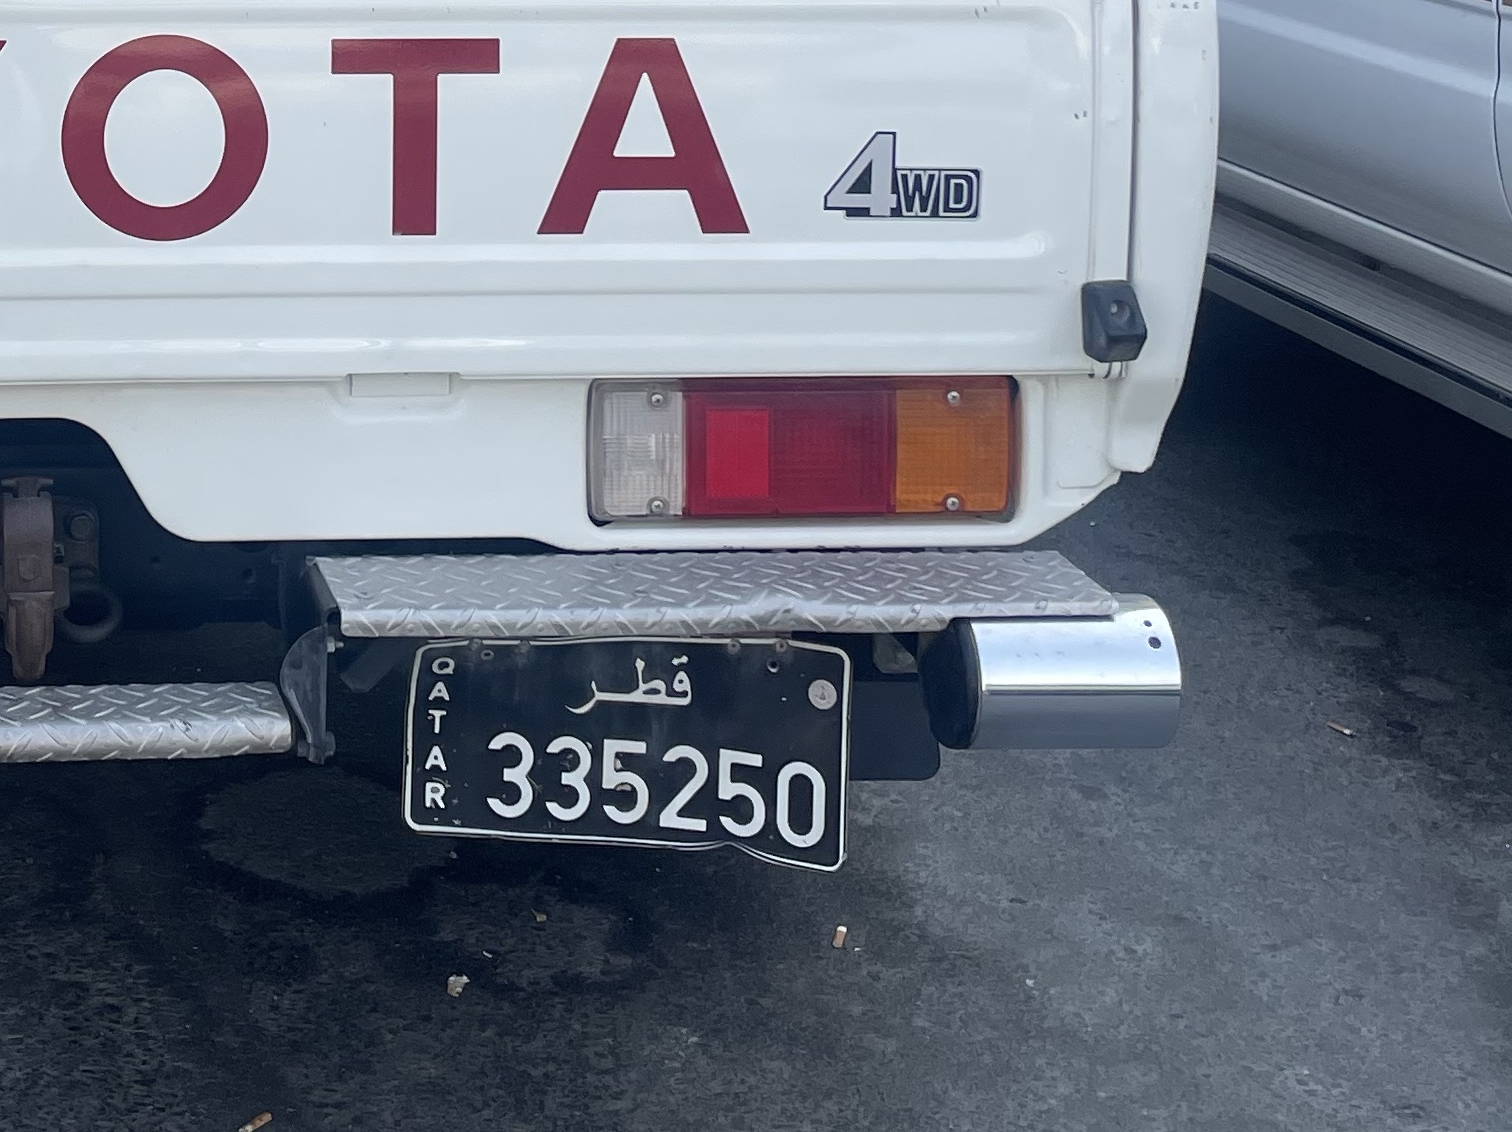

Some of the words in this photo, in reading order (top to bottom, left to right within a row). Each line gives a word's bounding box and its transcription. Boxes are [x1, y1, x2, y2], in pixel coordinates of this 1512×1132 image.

[823, 130, 982, 220] 4WD
[424, 656, 456, 810] QATAR
[564, 654, 693, 715] قطر
[486, 731, 827, 849] 335250
